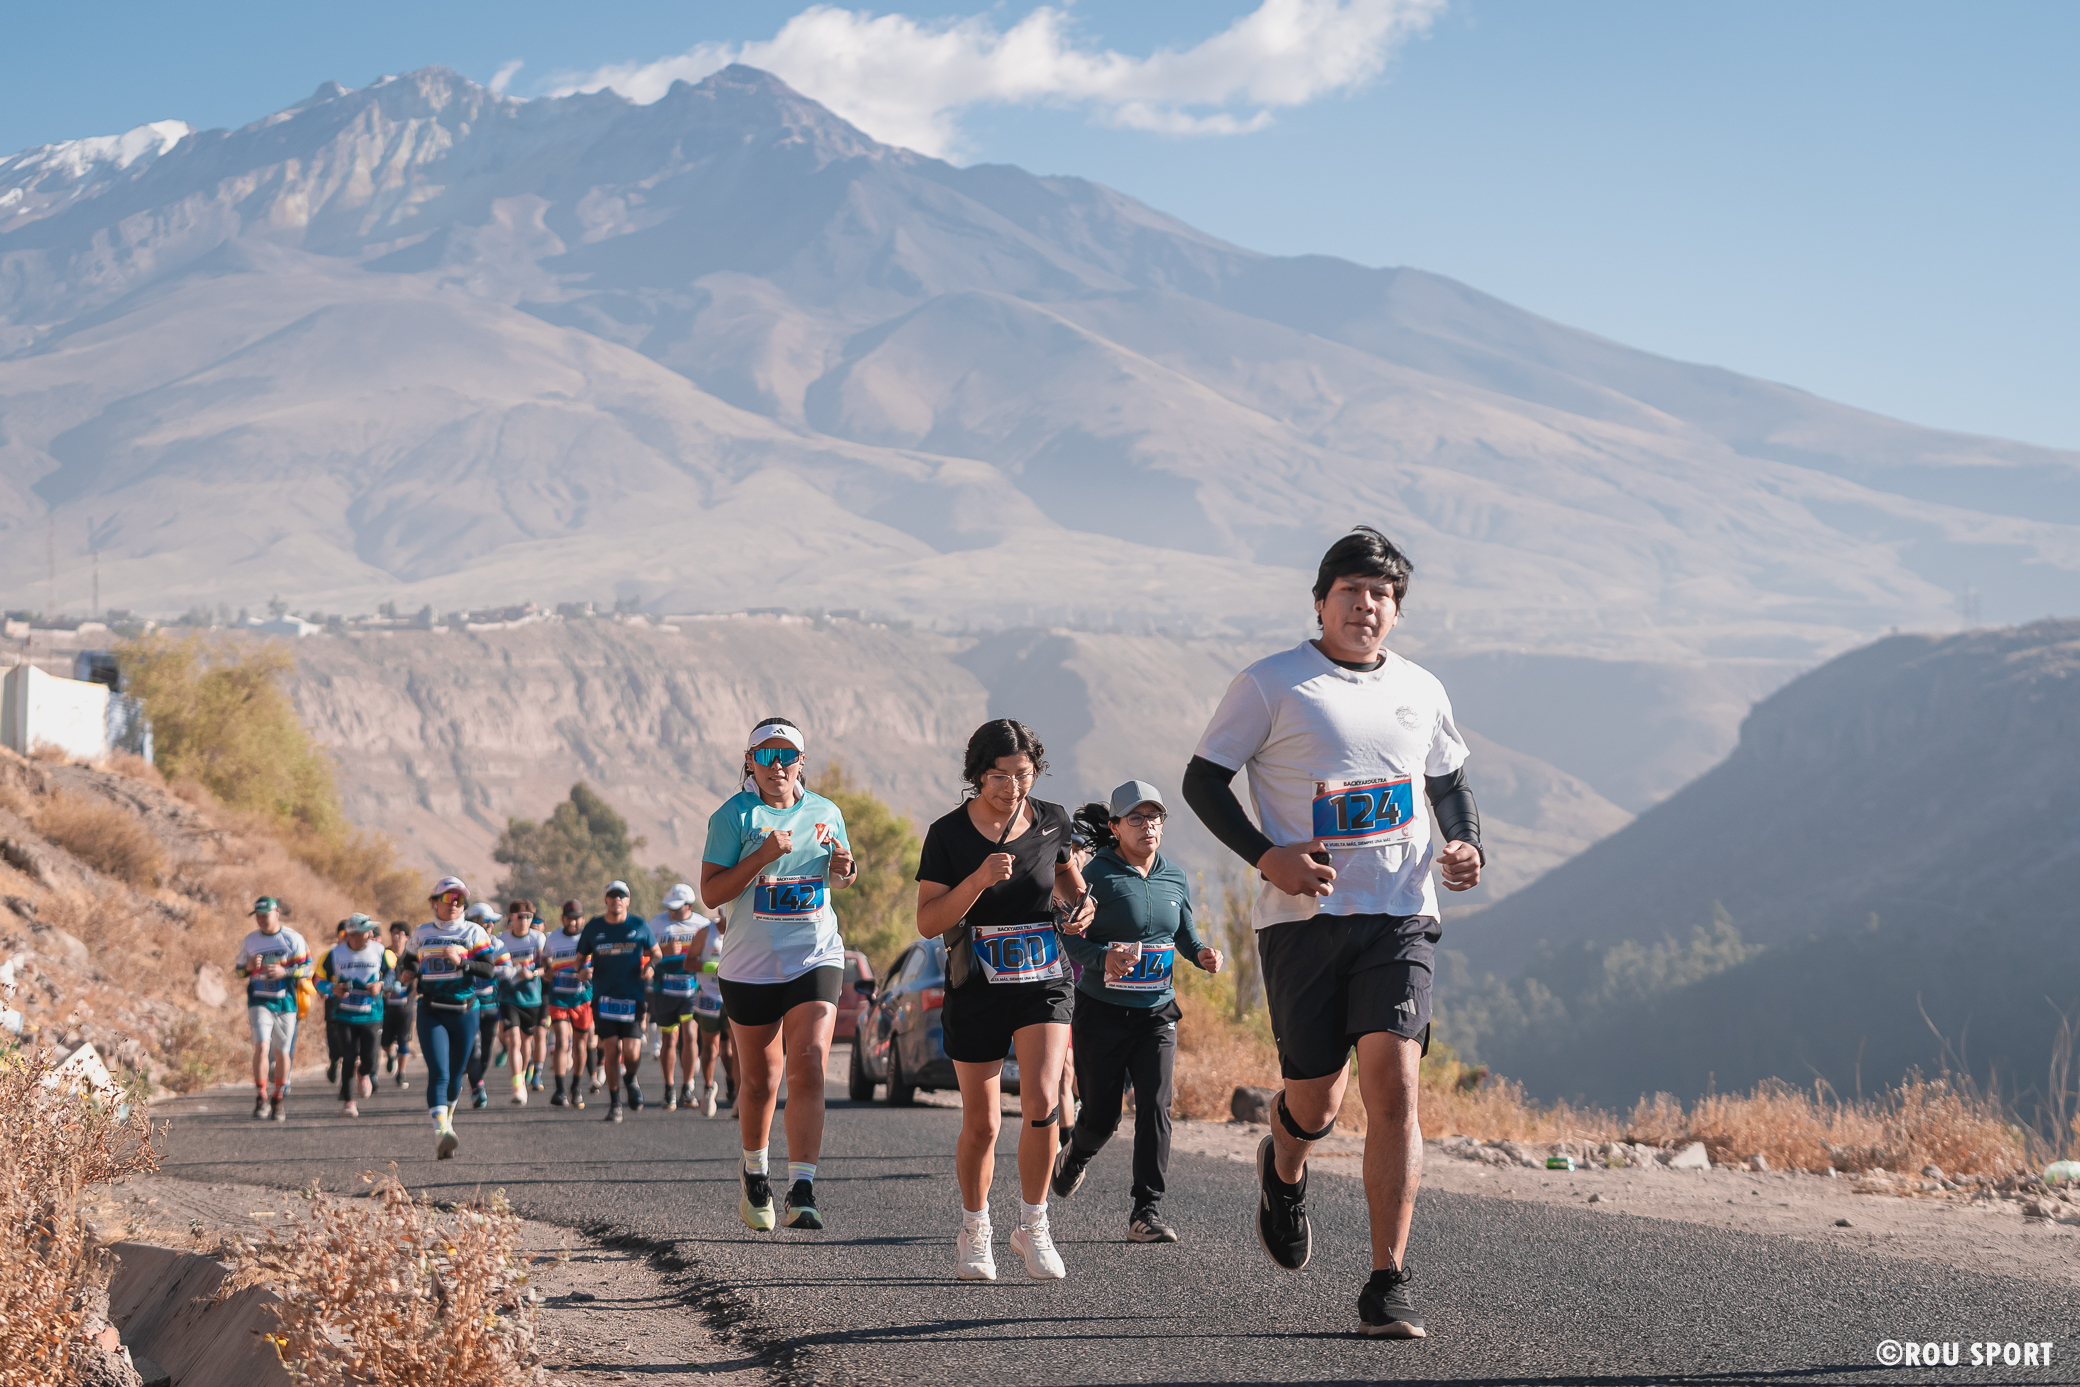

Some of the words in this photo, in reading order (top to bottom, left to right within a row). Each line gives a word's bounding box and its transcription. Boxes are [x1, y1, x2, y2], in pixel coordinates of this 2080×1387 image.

[1329, 790, 1401, 831] 124
[766, 885, 816, 911] 142
[984, 935, 1046, 969] 160
